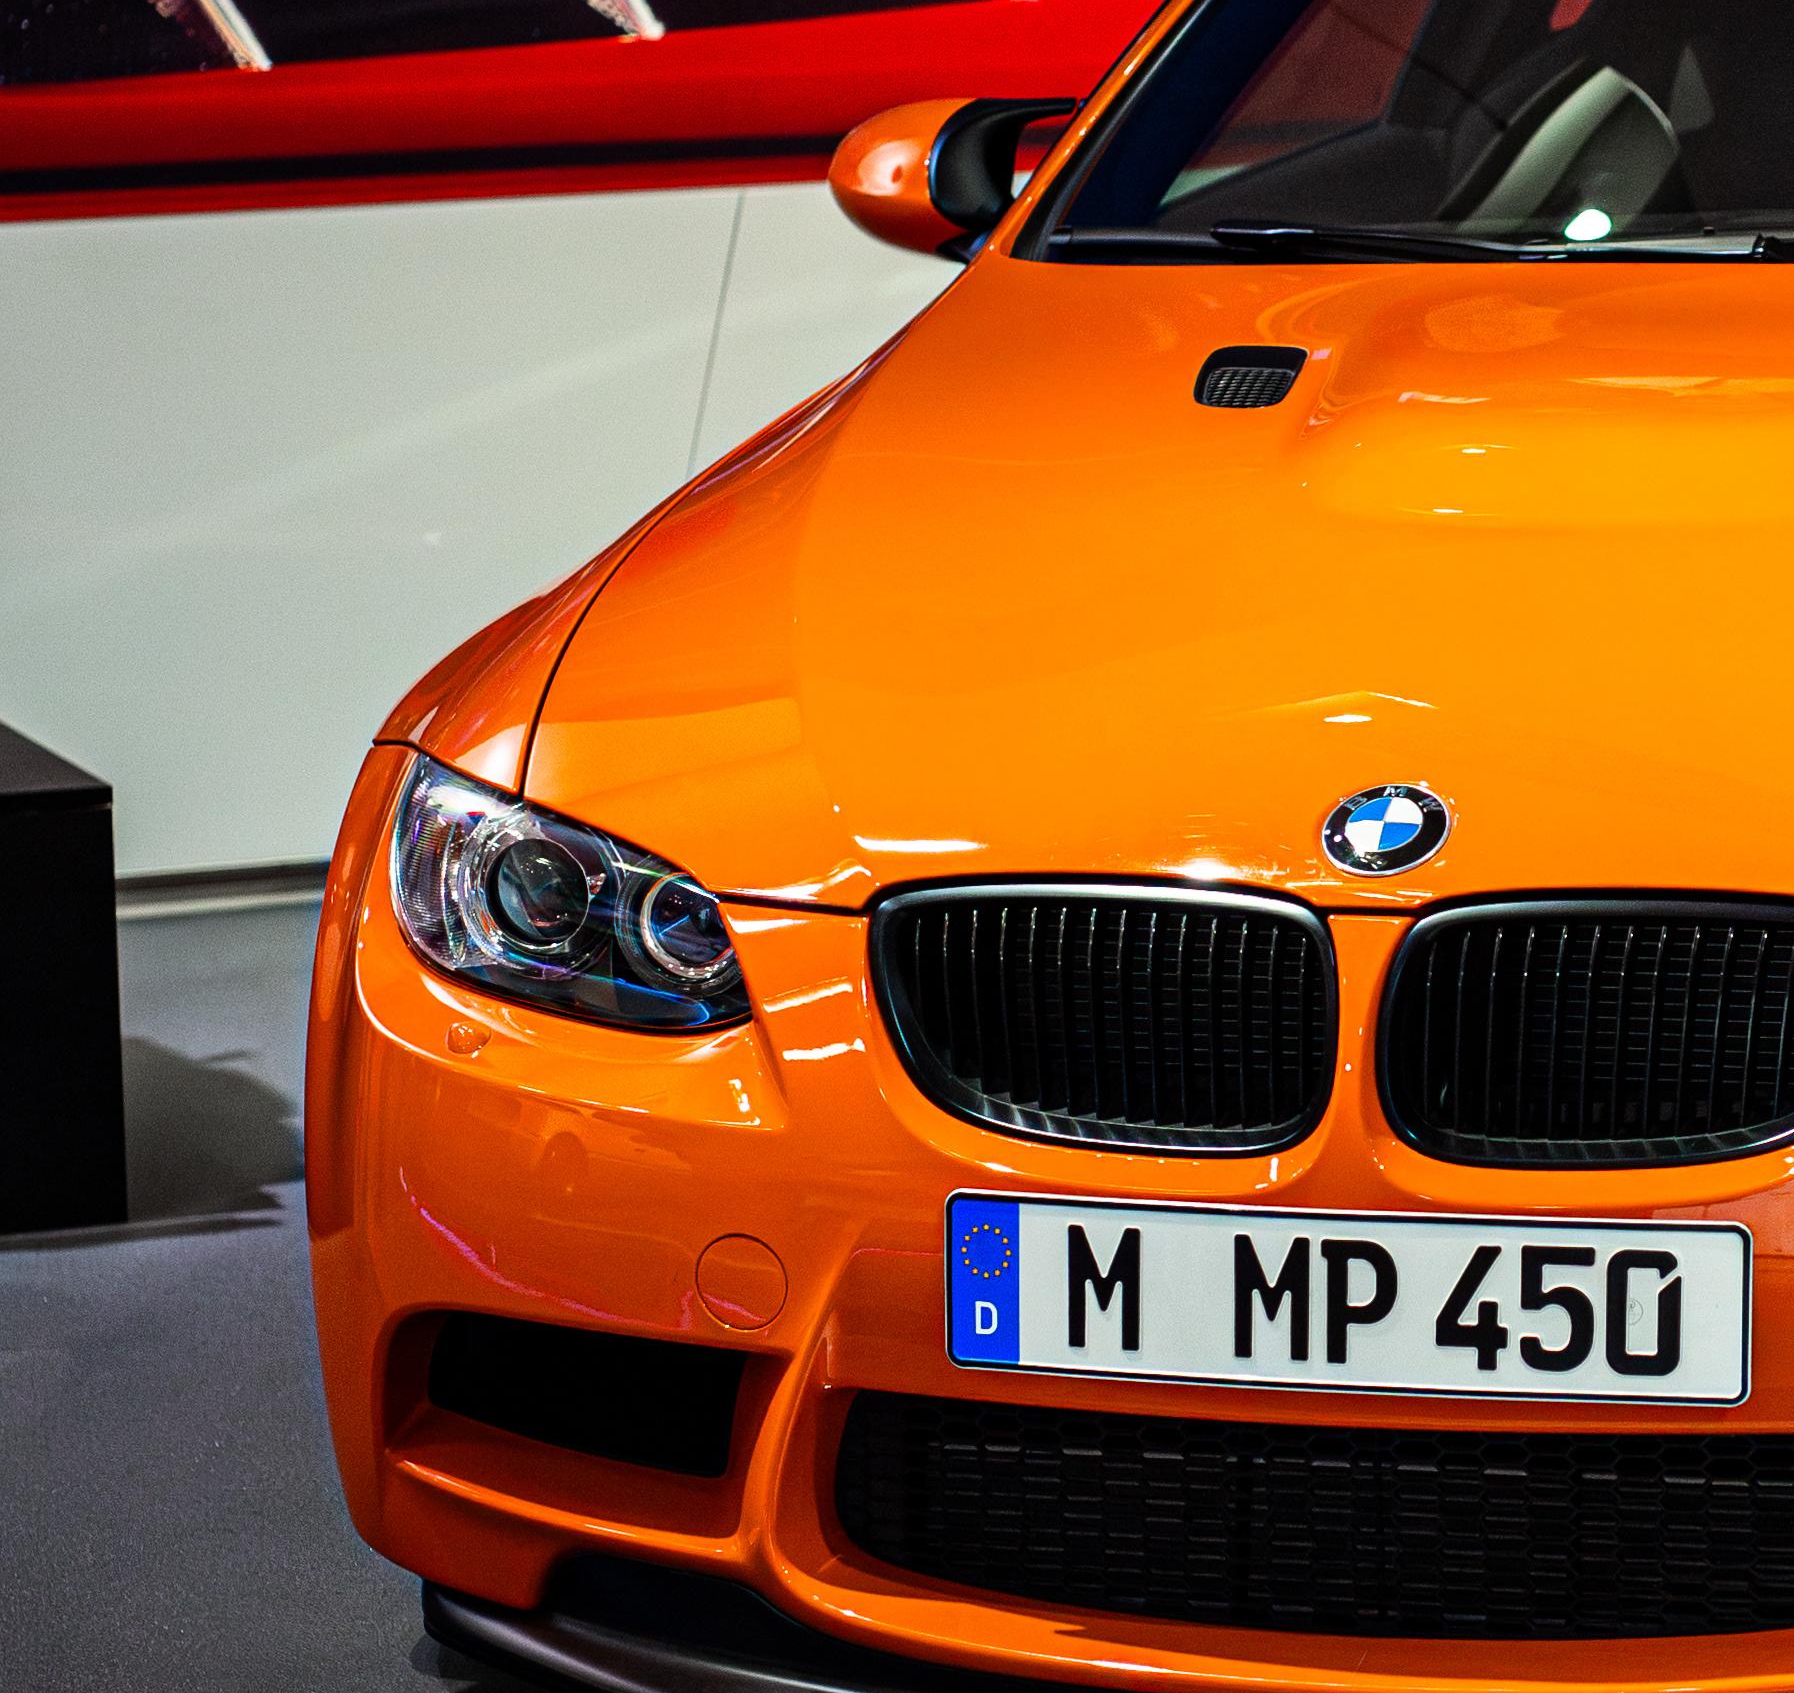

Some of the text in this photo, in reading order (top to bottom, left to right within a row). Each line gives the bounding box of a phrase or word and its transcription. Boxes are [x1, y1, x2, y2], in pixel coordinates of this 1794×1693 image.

[974, 1300, 999, 1336] D
[1066, 1223, 1683, 1377] M MP 450
